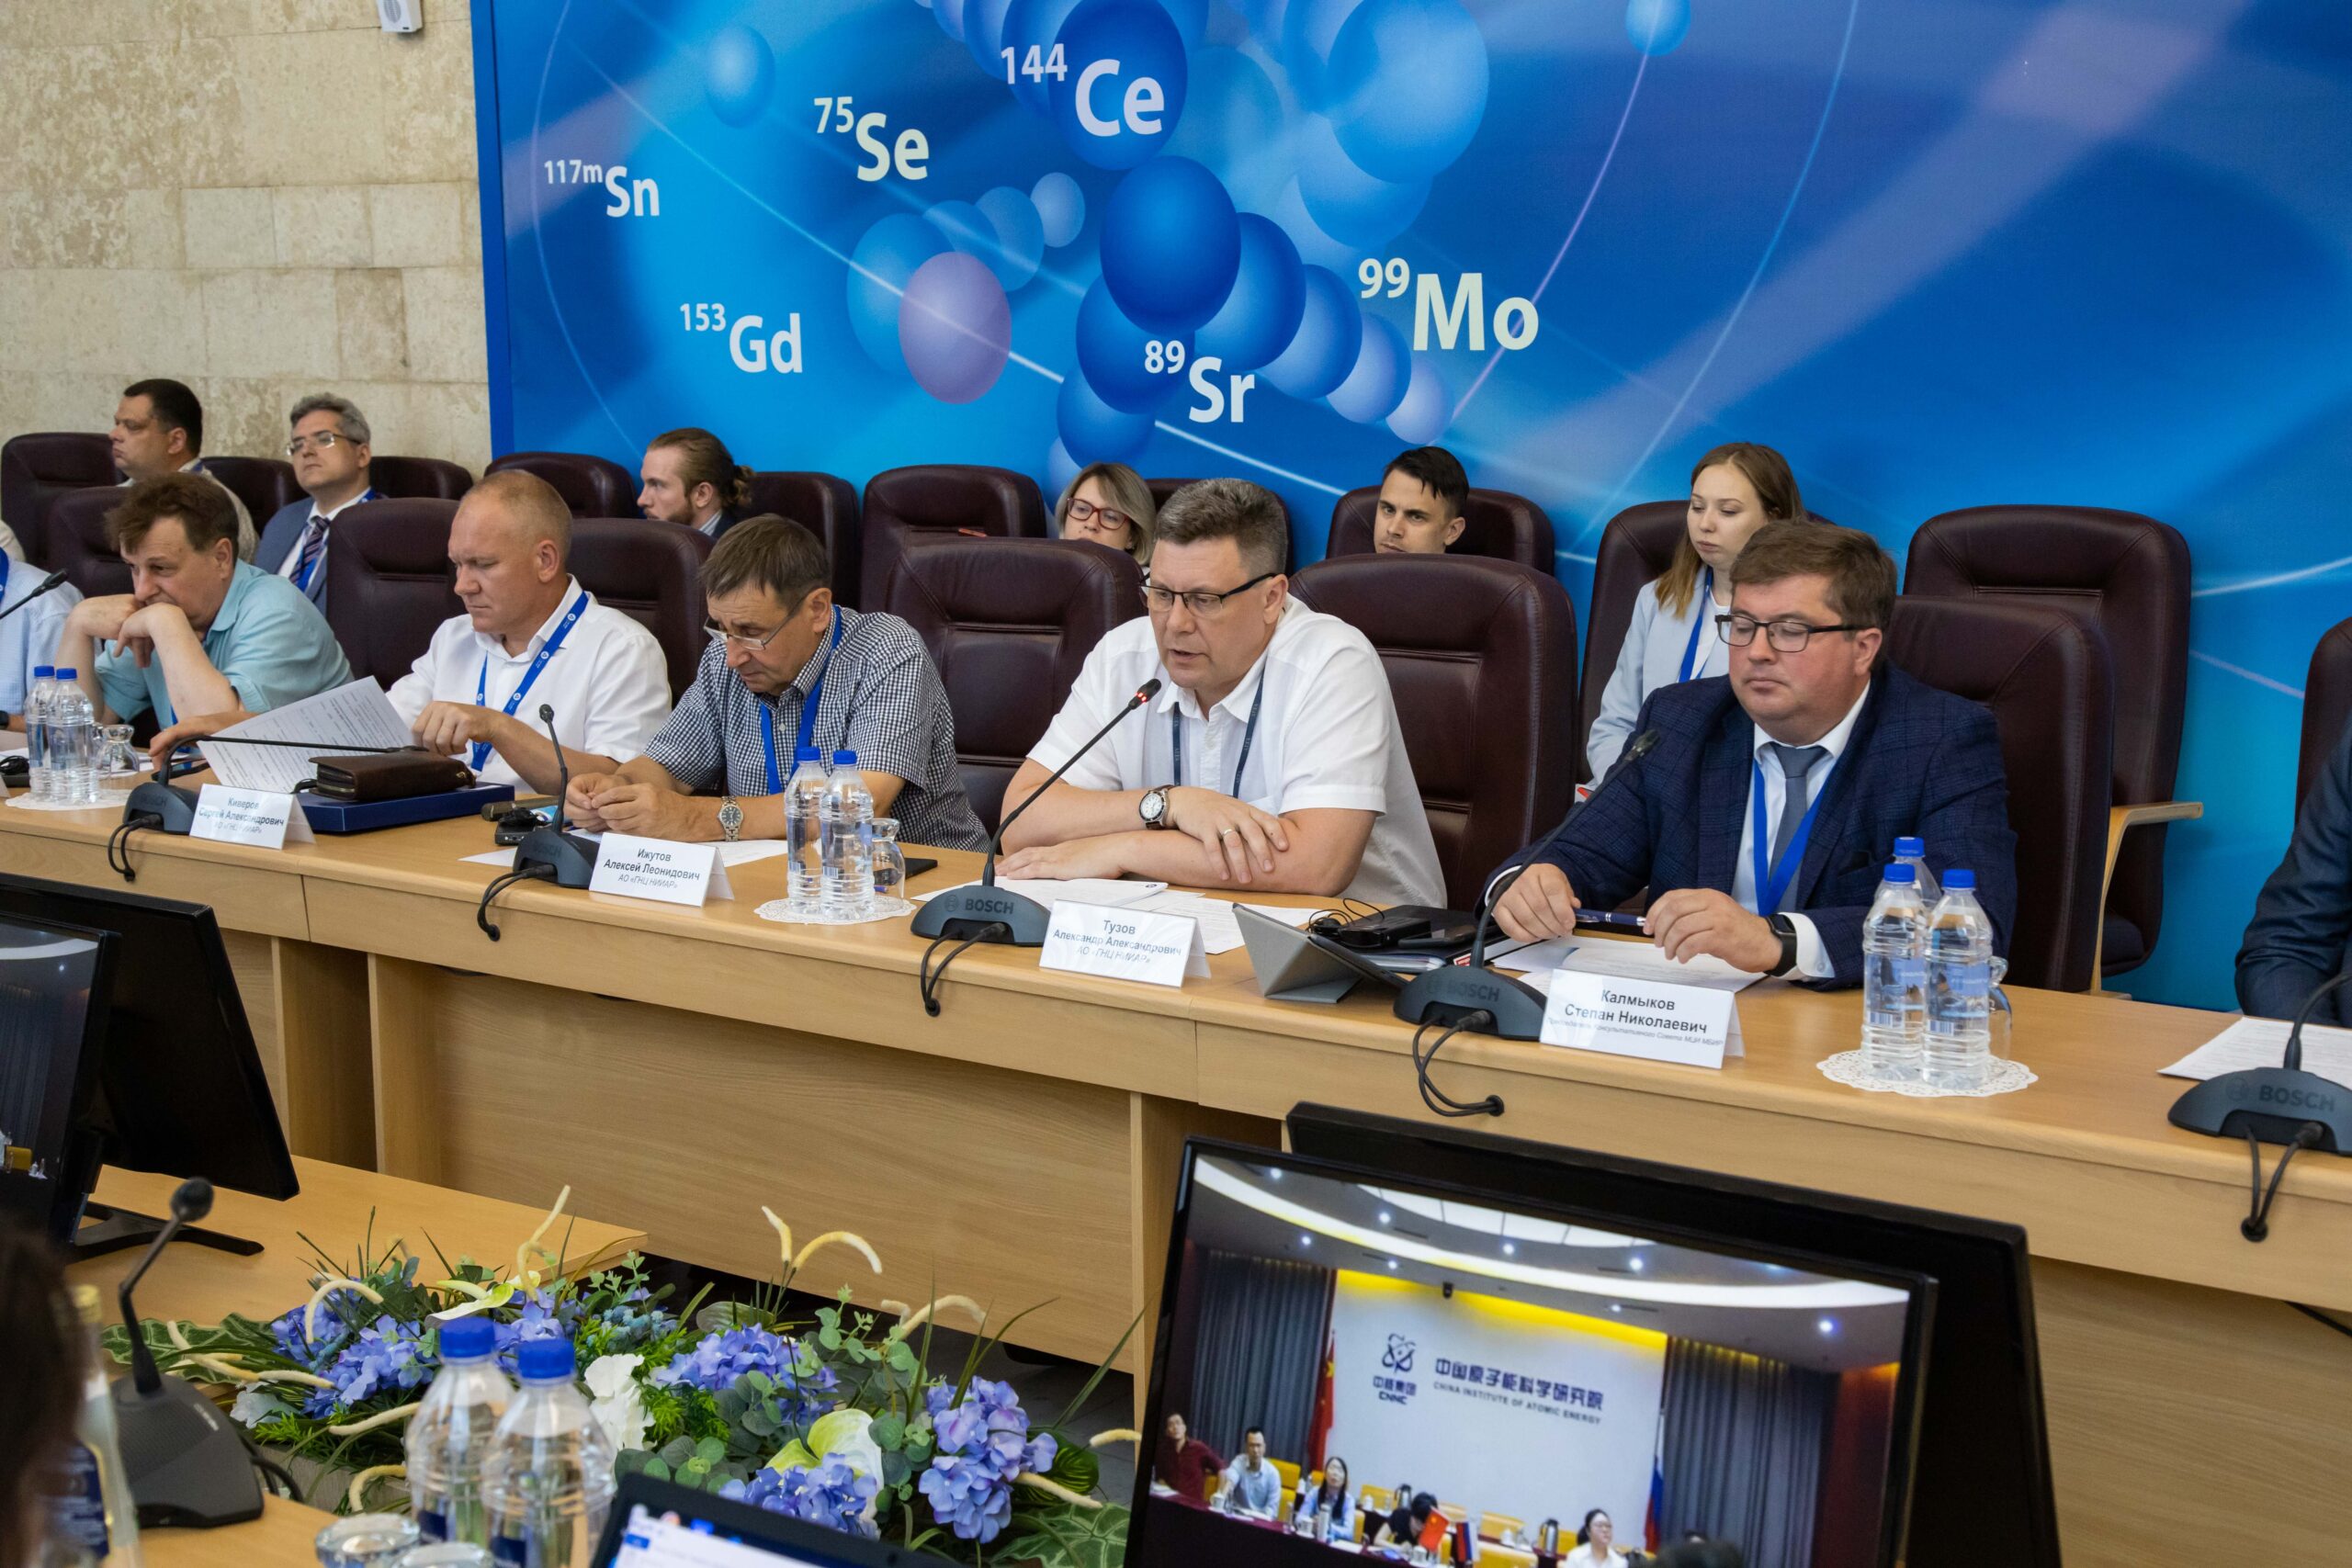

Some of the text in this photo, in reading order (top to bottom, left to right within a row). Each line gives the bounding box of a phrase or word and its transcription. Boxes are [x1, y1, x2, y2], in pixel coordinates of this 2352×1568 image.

[637, 848, 672, 863] Ижутов
[604, 859, 700, 881] Алексей Леонидович
[617, 874, 678, 889] АО «ГНЦ НИИАР»
[965, 898, 1015, 915] BOSCH
[1103, 919, 1136, 935] Тузов
[1053, 929, 1182, 956] Александр Александрович
[1447, 979, 1500, 1002] BOSCH
[1600, 988, 1676, 1010] Калмыков
[1565, 1003, 1707, 1033] Степан Николаевич
[2258, 1084, 2335, 1112] BOSCH
[1378, 1390, 1408, 1405] CNNC
[1433, 1381, 1601, 1425] CHINA INSTITUTE OF ATOMIC ENERGY
